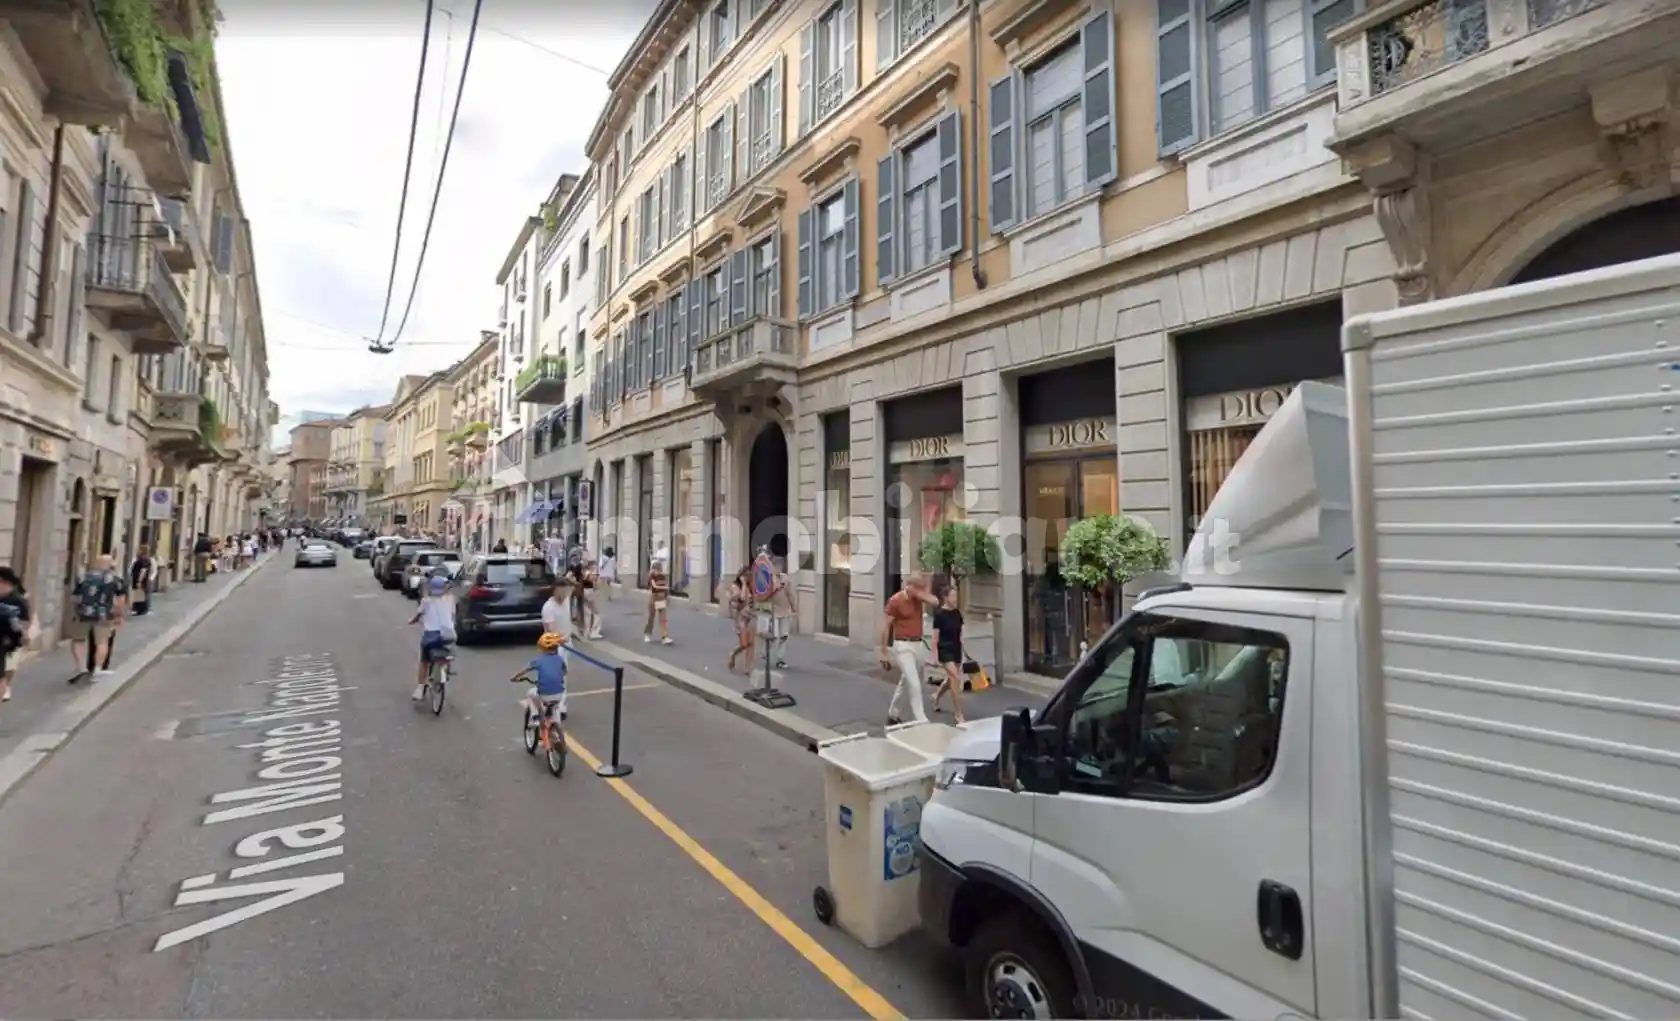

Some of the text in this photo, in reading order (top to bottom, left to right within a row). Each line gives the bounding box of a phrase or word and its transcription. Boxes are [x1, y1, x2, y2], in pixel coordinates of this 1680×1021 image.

[1219, 386, 1294, 422] DIO
[1049, 419, 1110, 447] DIOR
[829, 451, 850, 467] DIO
[909, 435, 950, 458] DIOR
